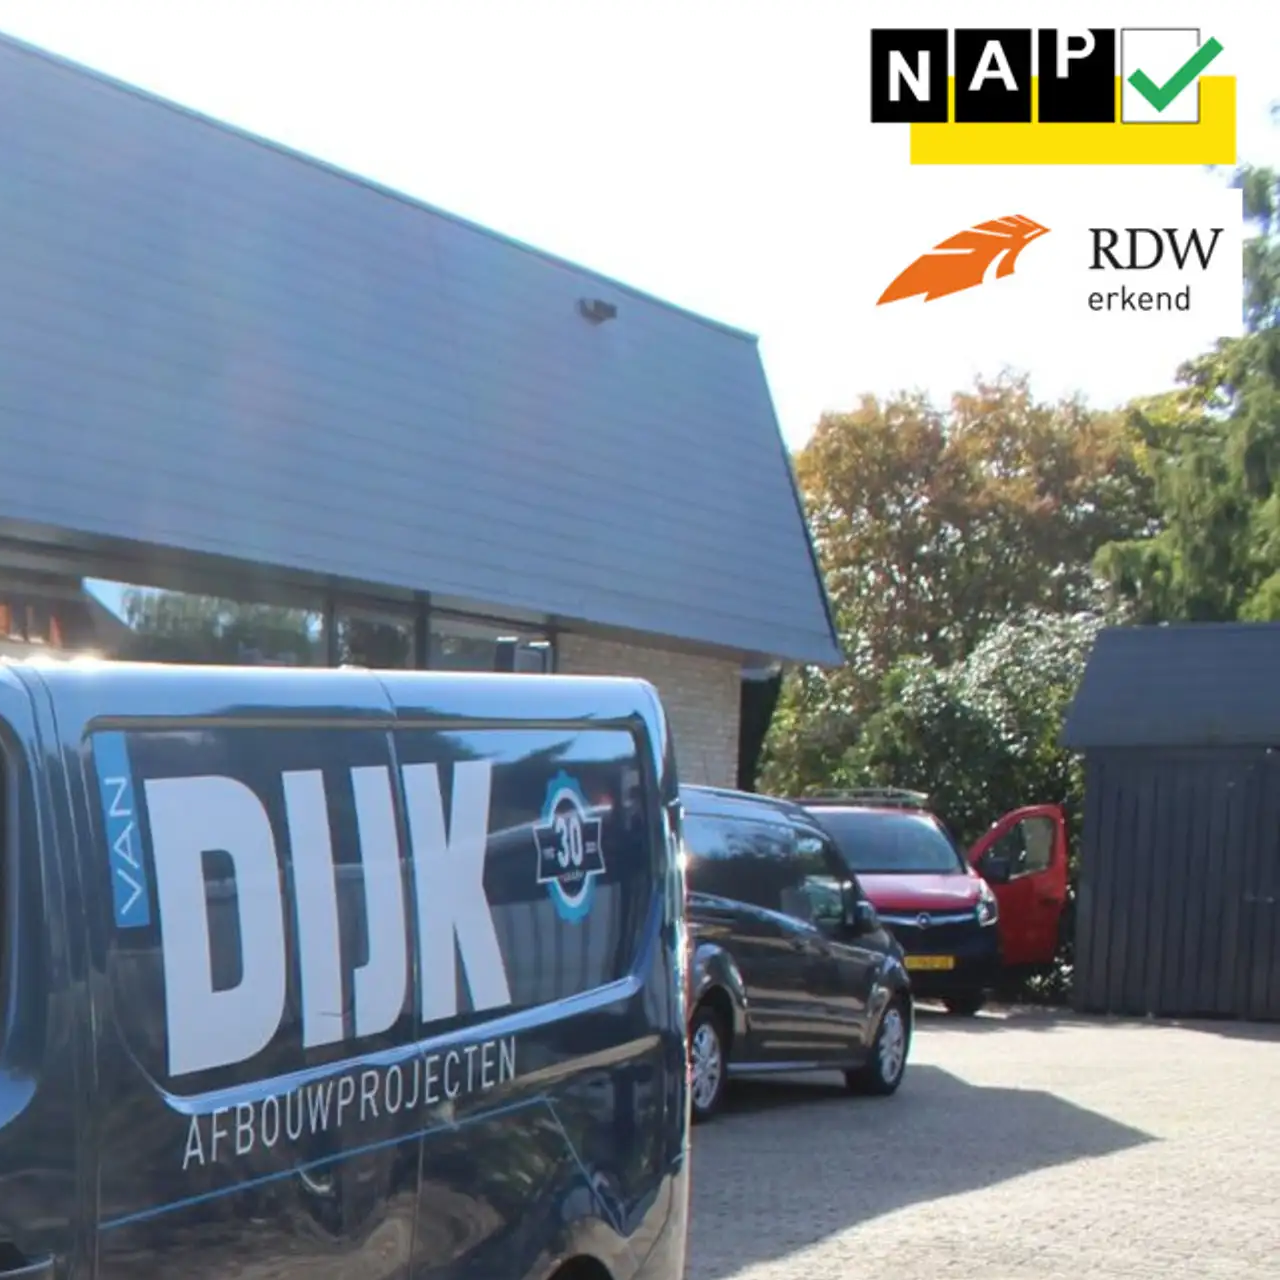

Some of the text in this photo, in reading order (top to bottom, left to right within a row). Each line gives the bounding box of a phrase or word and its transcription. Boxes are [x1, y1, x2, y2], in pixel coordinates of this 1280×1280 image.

[104, 776, 143, 915] VAN
[555, 816, 583, 868] 30
[143, 760, 512, 1077] DIJK
[182, 1036, 518, 1170] AFBOUWPROJECTEN
